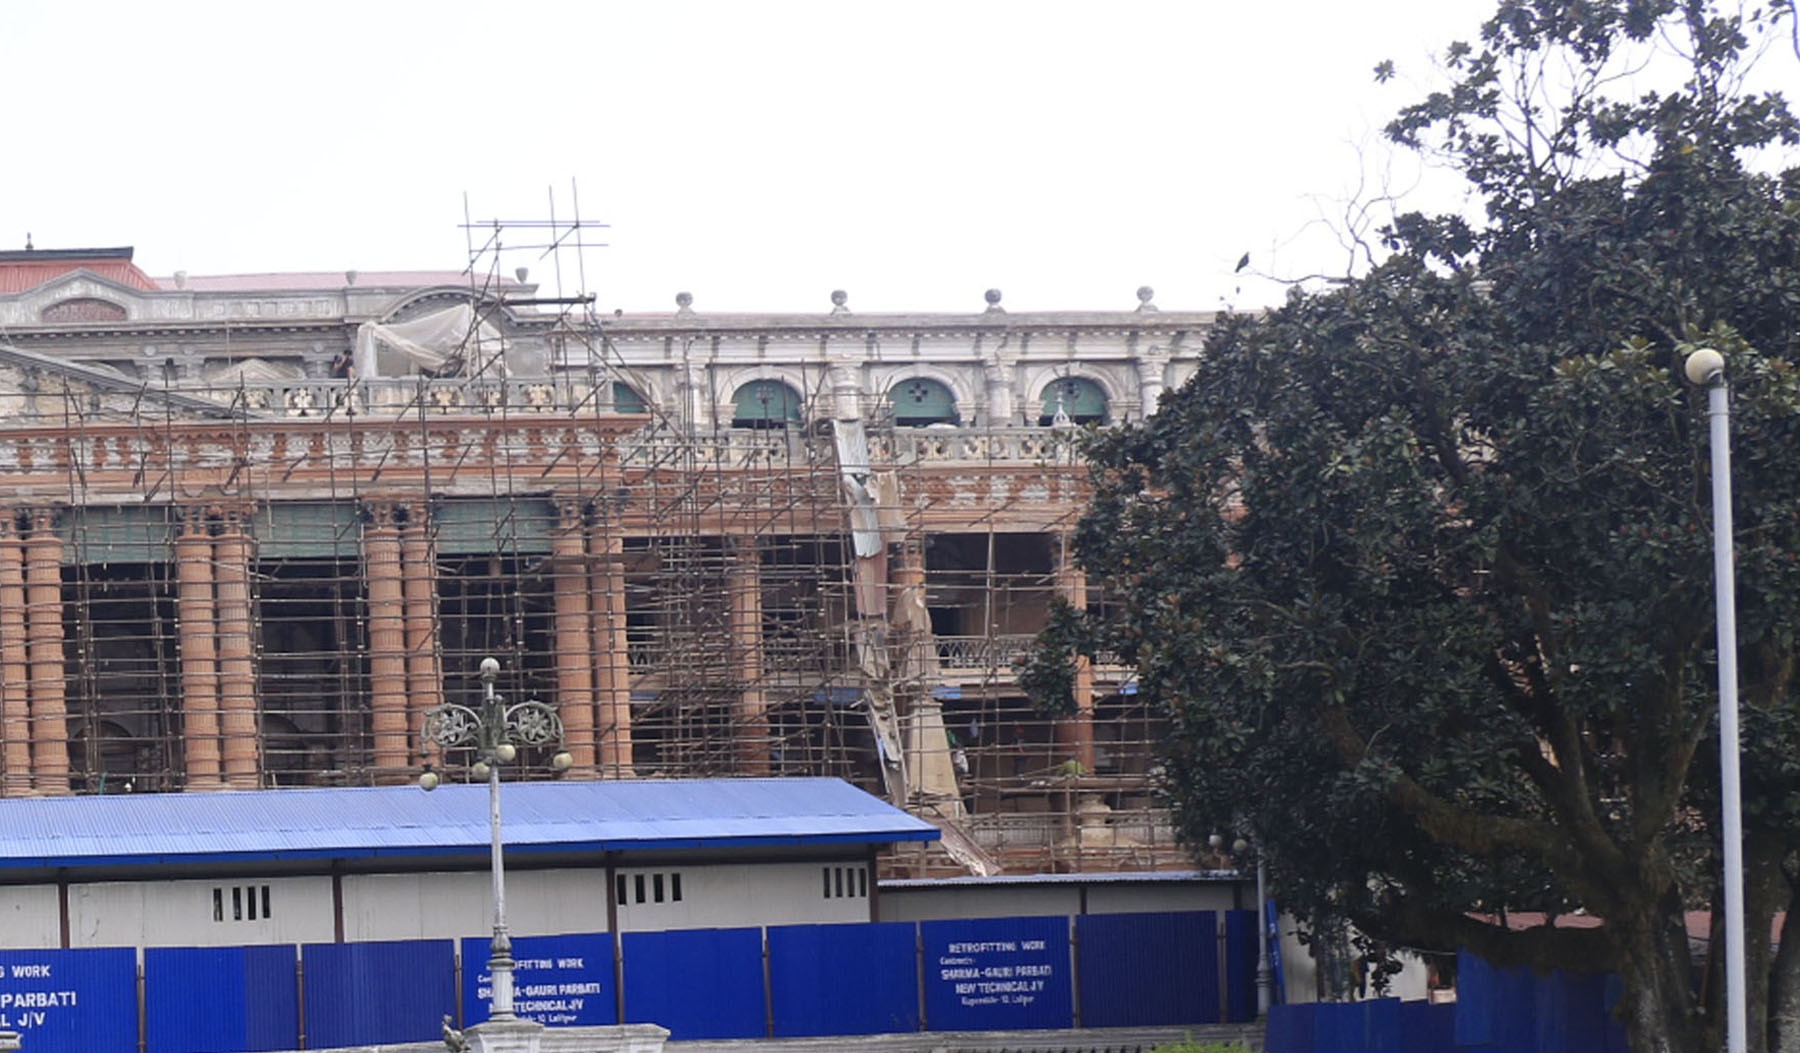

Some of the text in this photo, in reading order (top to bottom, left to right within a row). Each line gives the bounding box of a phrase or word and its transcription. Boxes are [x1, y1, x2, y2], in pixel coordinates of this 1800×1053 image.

[948, 940, 1046, 953] RETROFITTING WORK
[558, 958, 584, 969] WORK
[11, 965, 51, 978] WORK
[559, 983, 601, 995] PARBATI
[955, 982, 977, 994] NEW
[0, 991, 76, 1009] PARBATI
[17, 1012, 46, 1029] J/V
